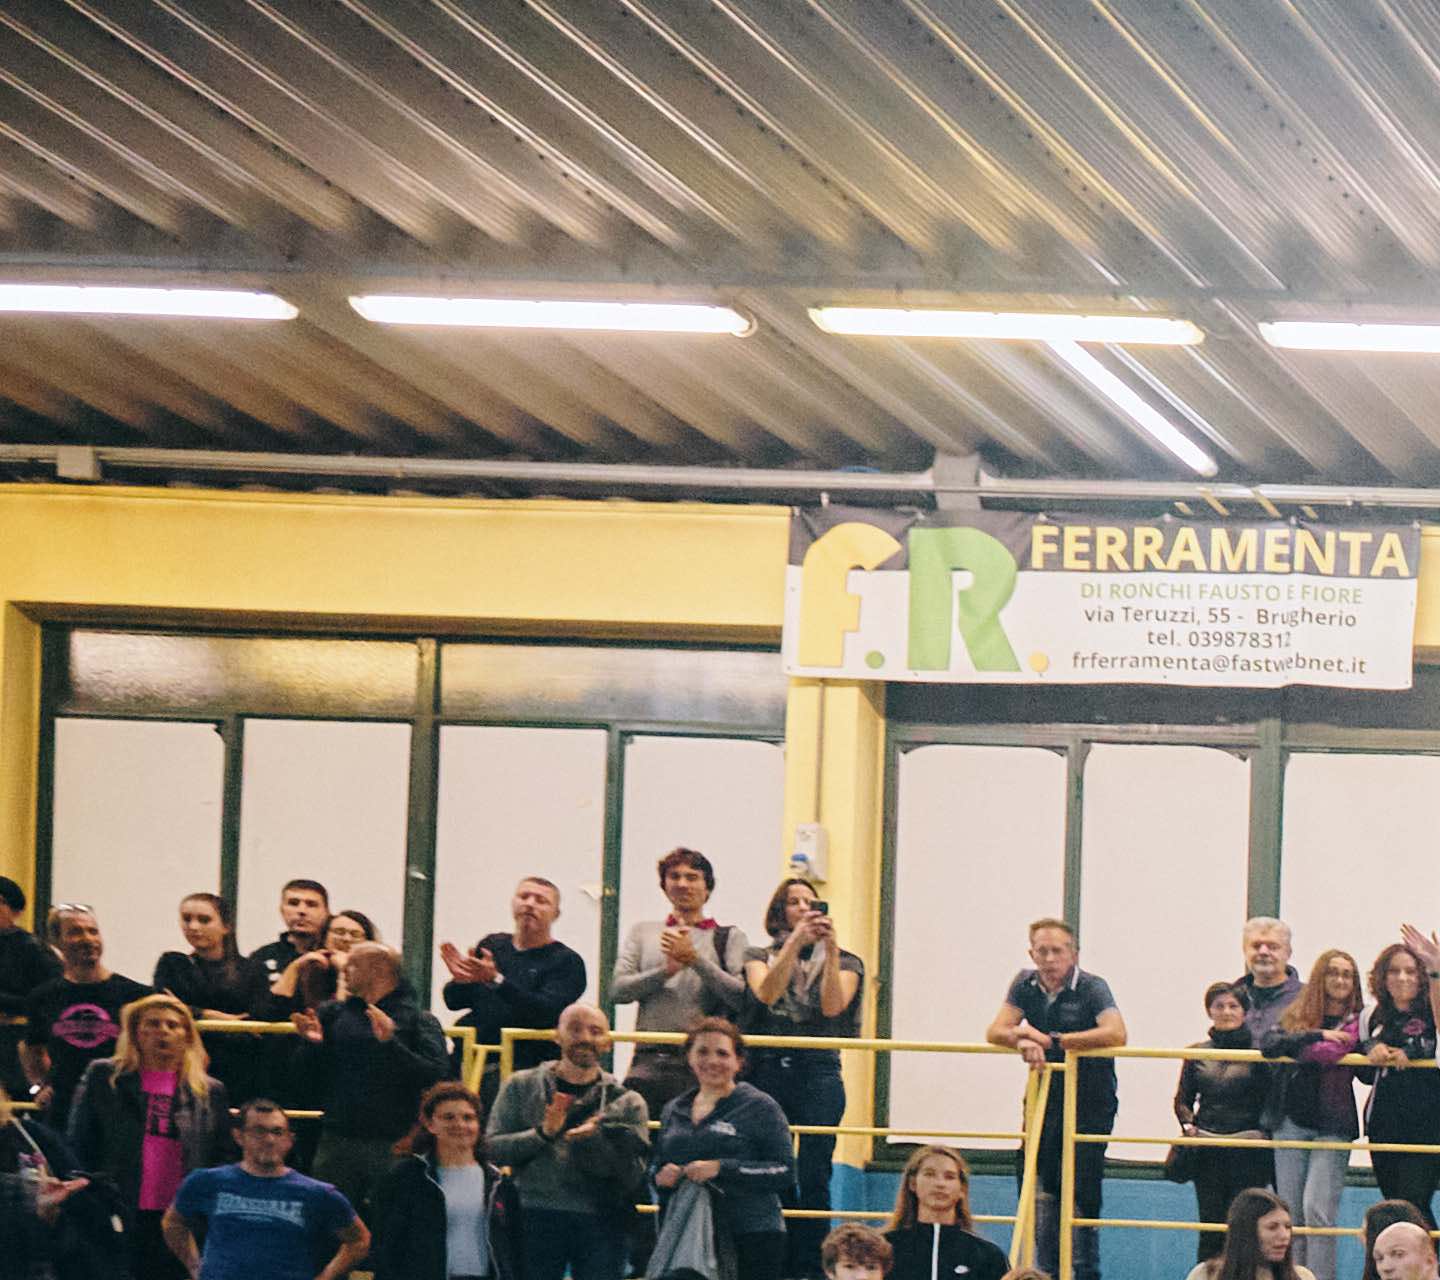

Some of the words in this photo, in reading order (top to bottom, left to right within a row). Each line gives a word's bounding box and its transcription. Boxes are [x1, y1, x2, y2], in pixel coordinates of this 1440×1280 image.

[1031, 525, 1410, 578] FERRAMENTA
[1080, 583, 1102, 599] DI
[1109, 583, 1191, 600] RONCHI
[1199, 584, 1281, 602] FAUSTO
[1287, 585, 1296, 600] E
[1302, 585, 1364, 605] FIORE
[1084, 606, 1115, 623] via
[1120, 606, 1201, 626] Teruzzi,
[1208, 607, 1231, 624] 55
[1256, 607, 1357, 628] Brugherio
[1147, 629, 1181, 647] tel.
